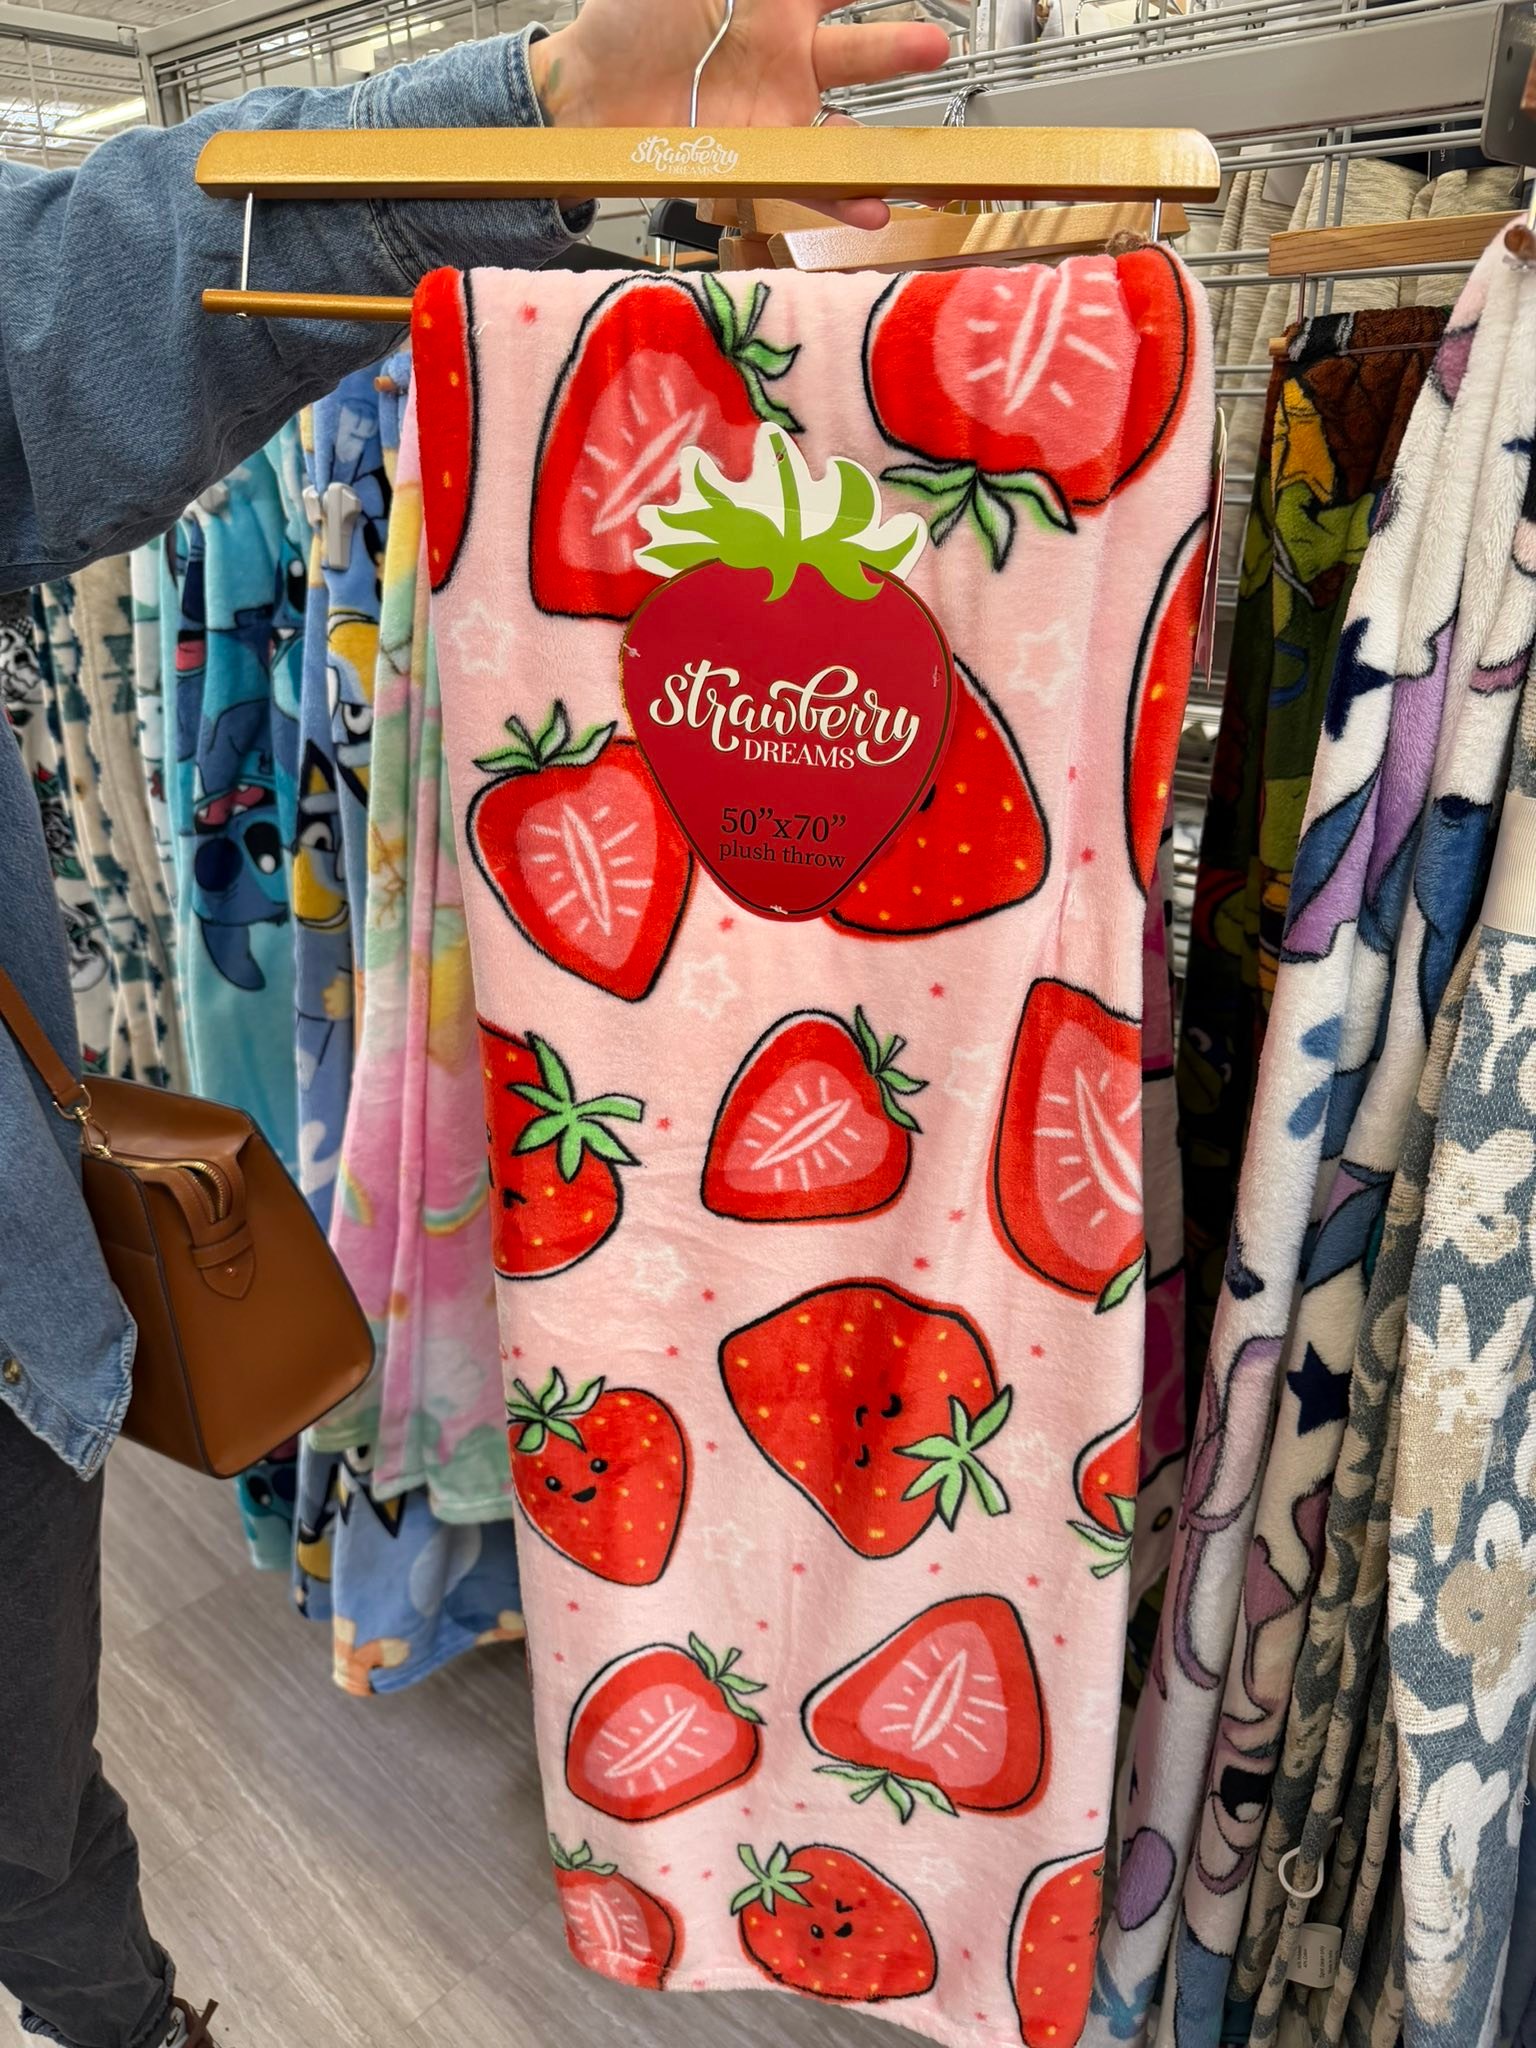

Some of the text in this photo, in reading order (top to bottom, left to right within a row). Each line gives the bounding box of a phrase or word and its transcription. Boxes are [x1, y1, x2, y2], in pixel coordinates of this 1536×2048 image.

[668, 165, 713, 175] DREAMS
[743, 738, 855, 769] DREAMS
[719, 840, 846, 869] plush throw
